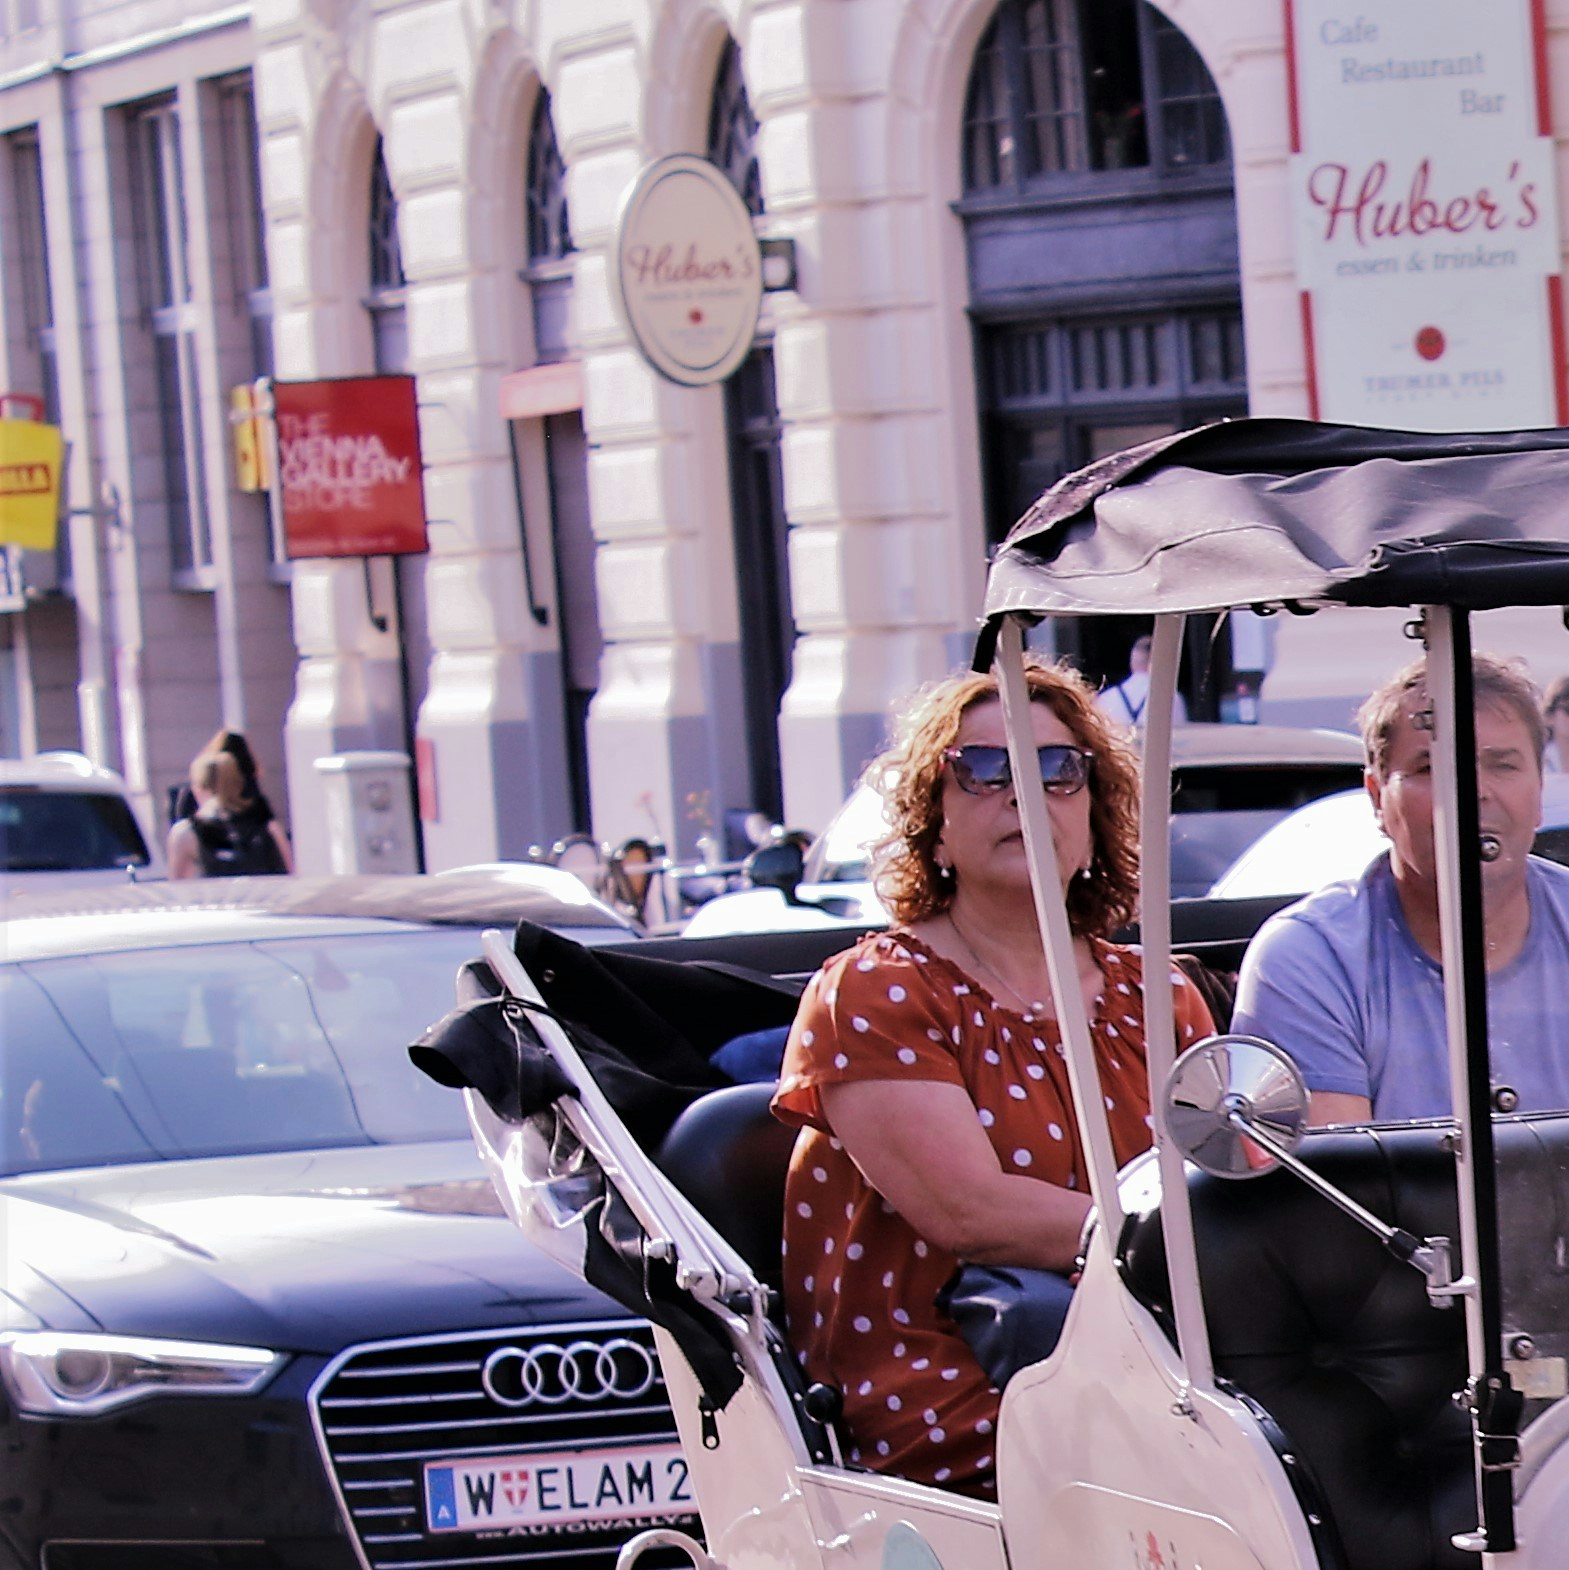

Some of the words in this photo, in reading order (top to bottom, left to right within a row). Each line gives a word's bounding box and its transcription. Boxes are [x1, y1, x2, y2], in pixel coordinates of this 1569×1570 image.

[1320, 16, 1379, 45] Cafe
[1341, 52, 1485, 83] Restaurant
[1460, 89, 1506, 115] Bar
[1308, 158, 1538, 247] Huber's
[627, 242, 753, 283] Huber's
[1336, 257, 1399, 276] essen
[1407, 251, 1424, 271] &
[1434, 244, 1517, 270] trinken
[278, 413, 329, 437] THE
[279, 434, 386, 463] VIENNA
[283, 456, 411, 489] GALLERY
[284, 485, 374, 513] STORE
[464, 1472, 495, 1516] W
[536, 1461, 654, 1510] ELAM
[667, 1459, 691, 1500] 2
[437, 1505, 450, 1519] A
